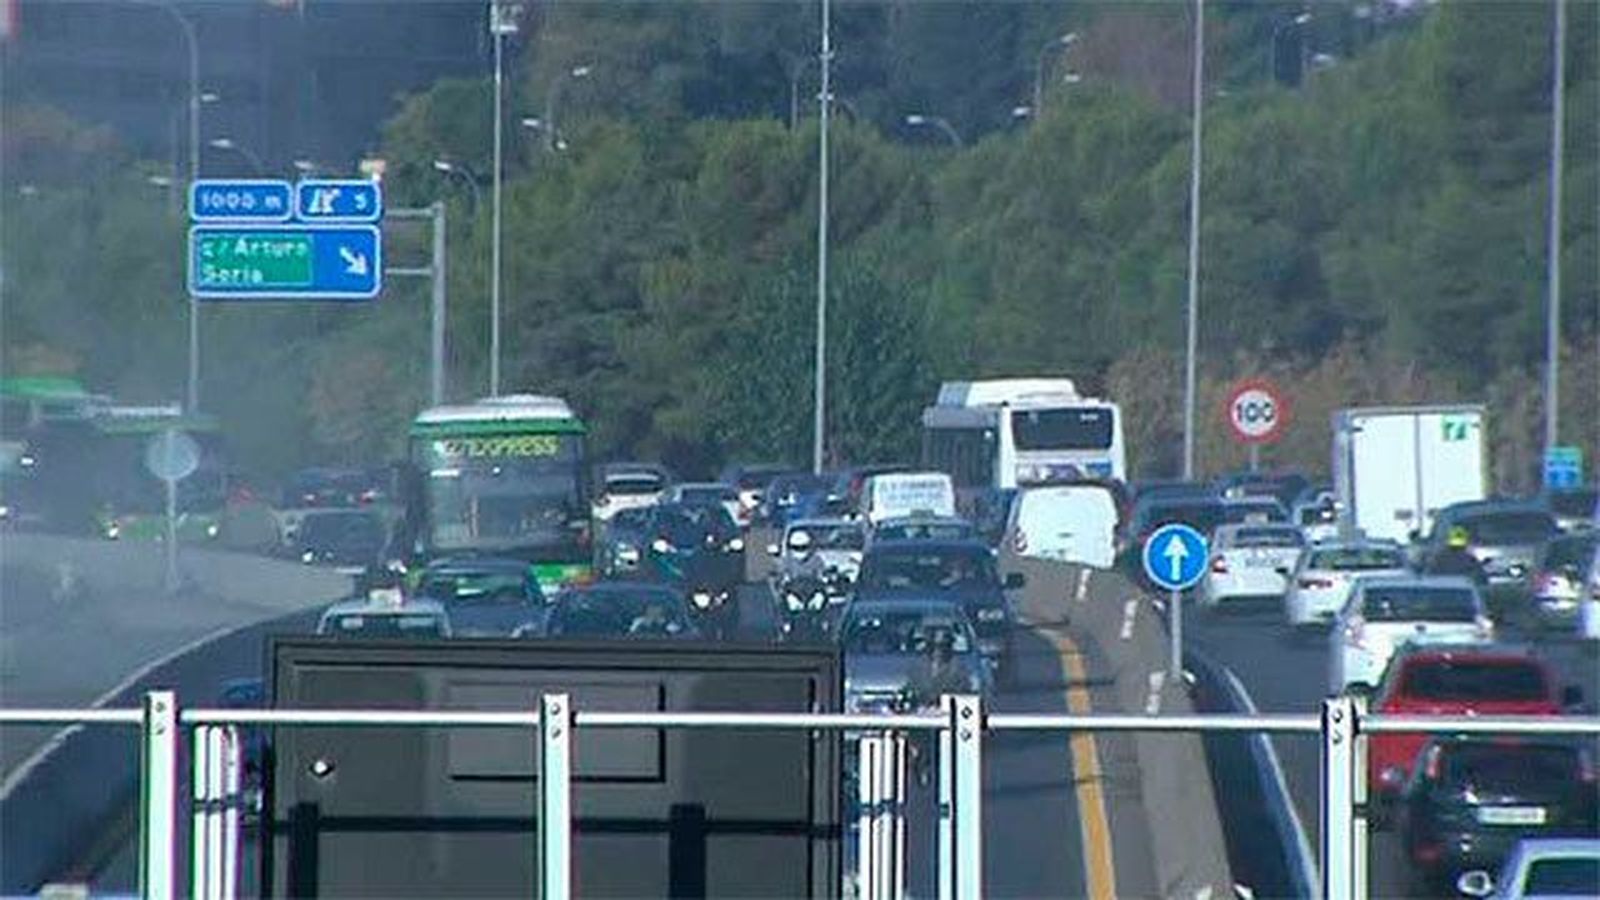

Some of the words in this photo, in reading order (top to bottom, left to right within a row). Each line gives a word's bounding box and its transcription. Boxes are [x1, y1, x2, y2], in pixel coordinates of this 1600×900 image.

[201, 191, 256, 210] 1000
[264, 195, 282, 208] m
[1237, 402, 1274, 424] 100
